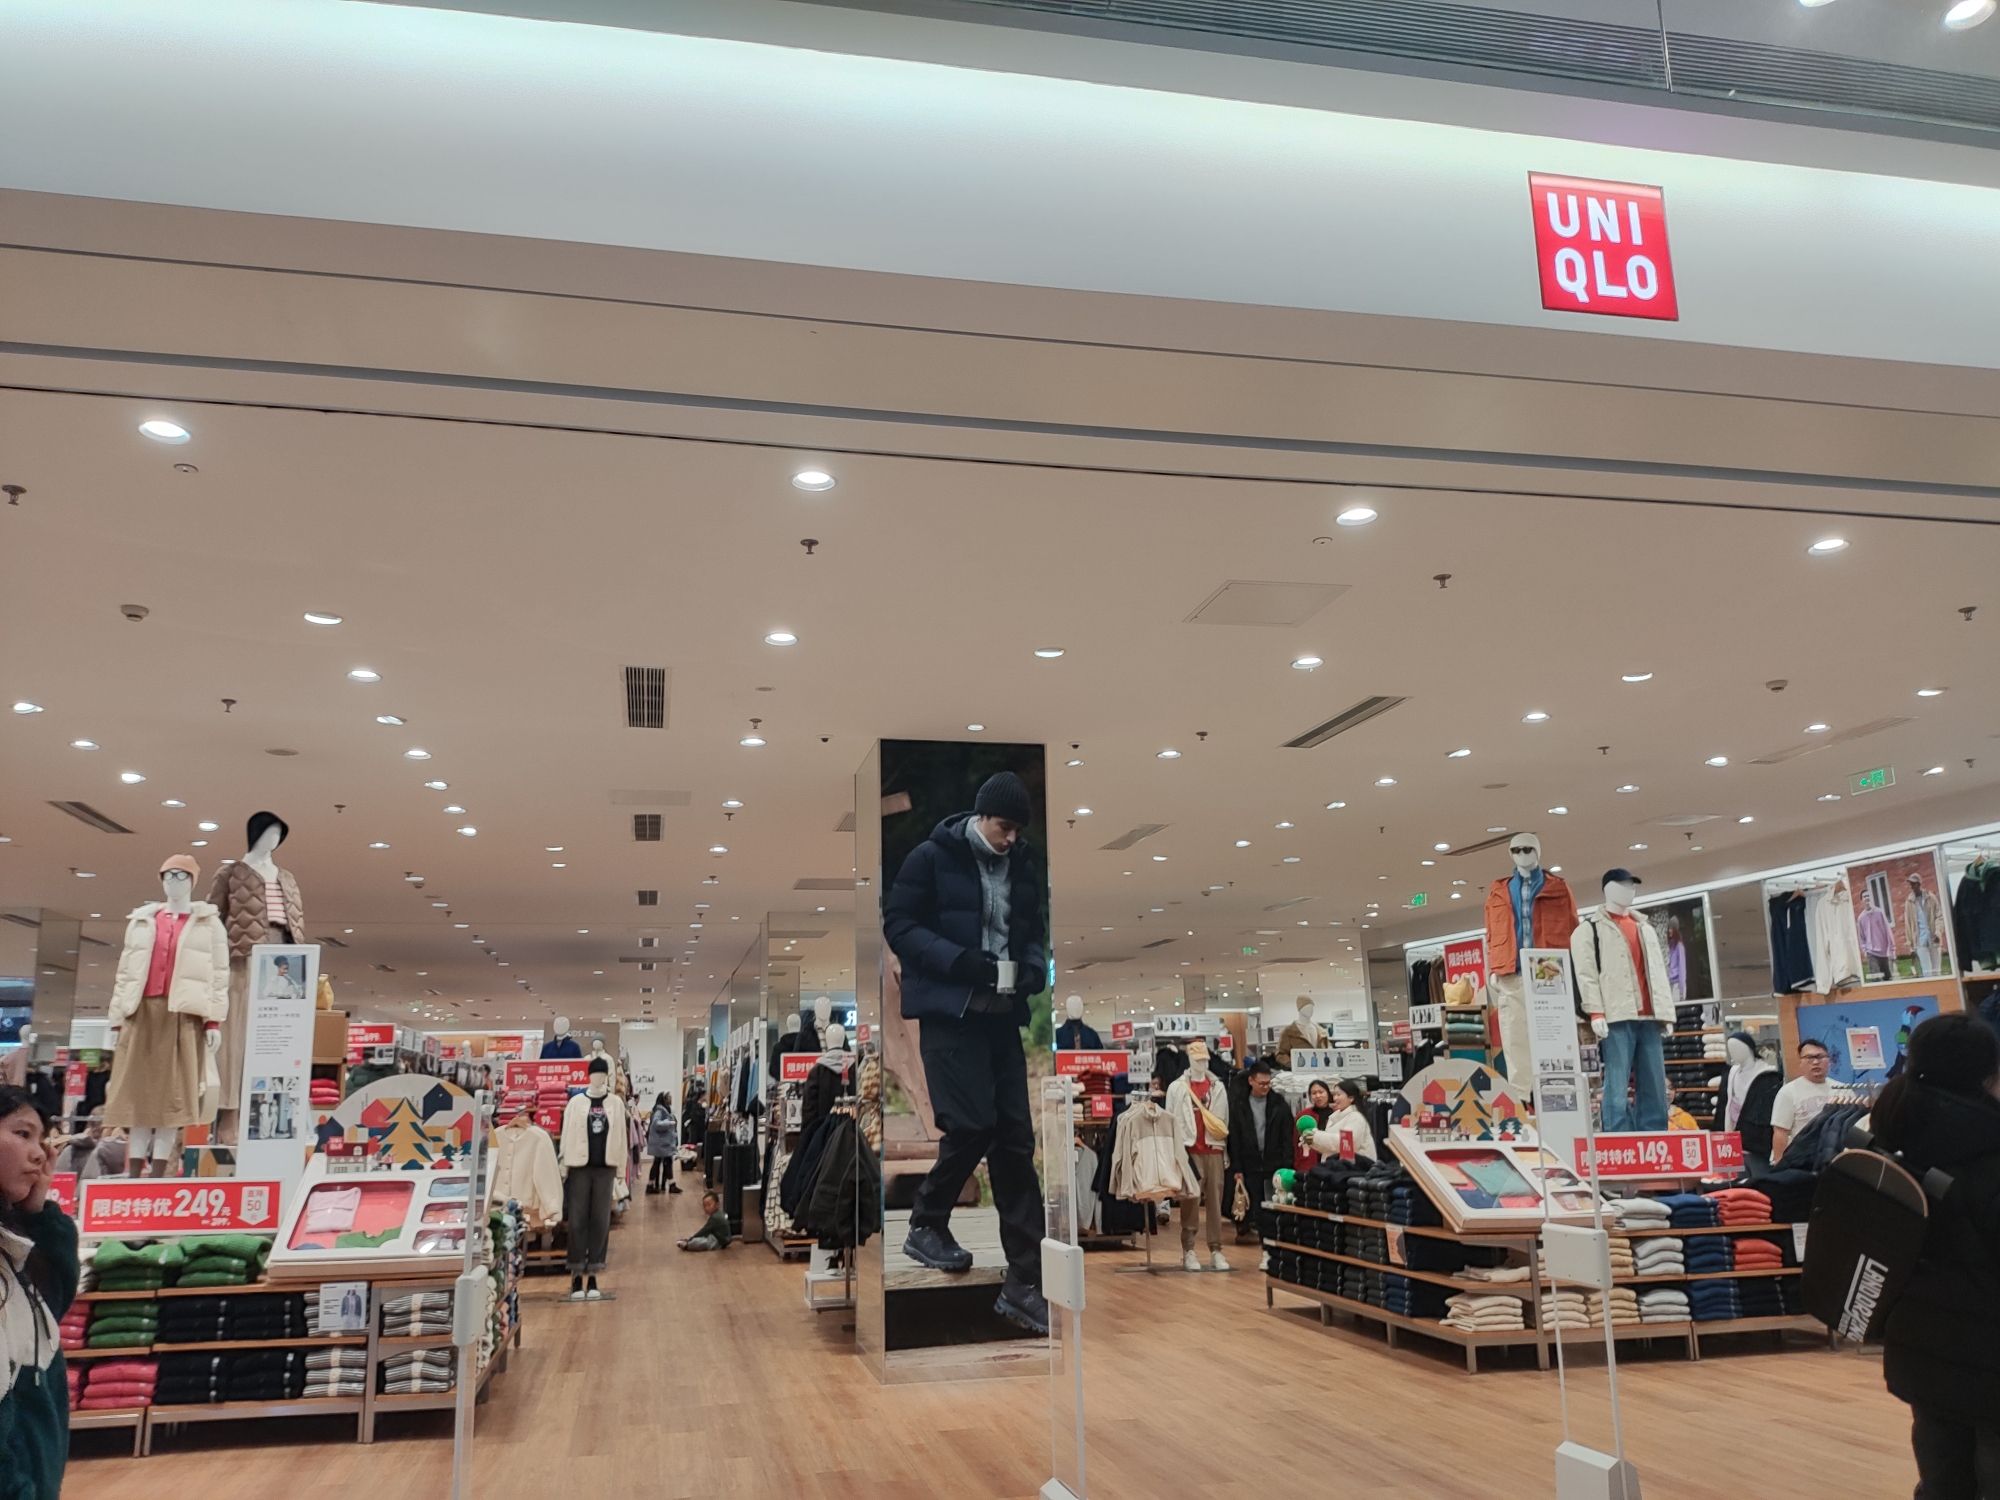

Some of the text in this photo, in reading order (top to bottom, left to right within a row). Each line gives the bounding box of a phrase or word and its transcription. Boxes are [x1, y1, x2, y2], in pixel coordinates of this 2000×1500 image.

[1546, 192, 1643, 246] UNI
[1554, 247, 1659, 304] QLO
[91, 1197, 172, 1218] 限时特优
[247, 1200, 262, 1212] 50
